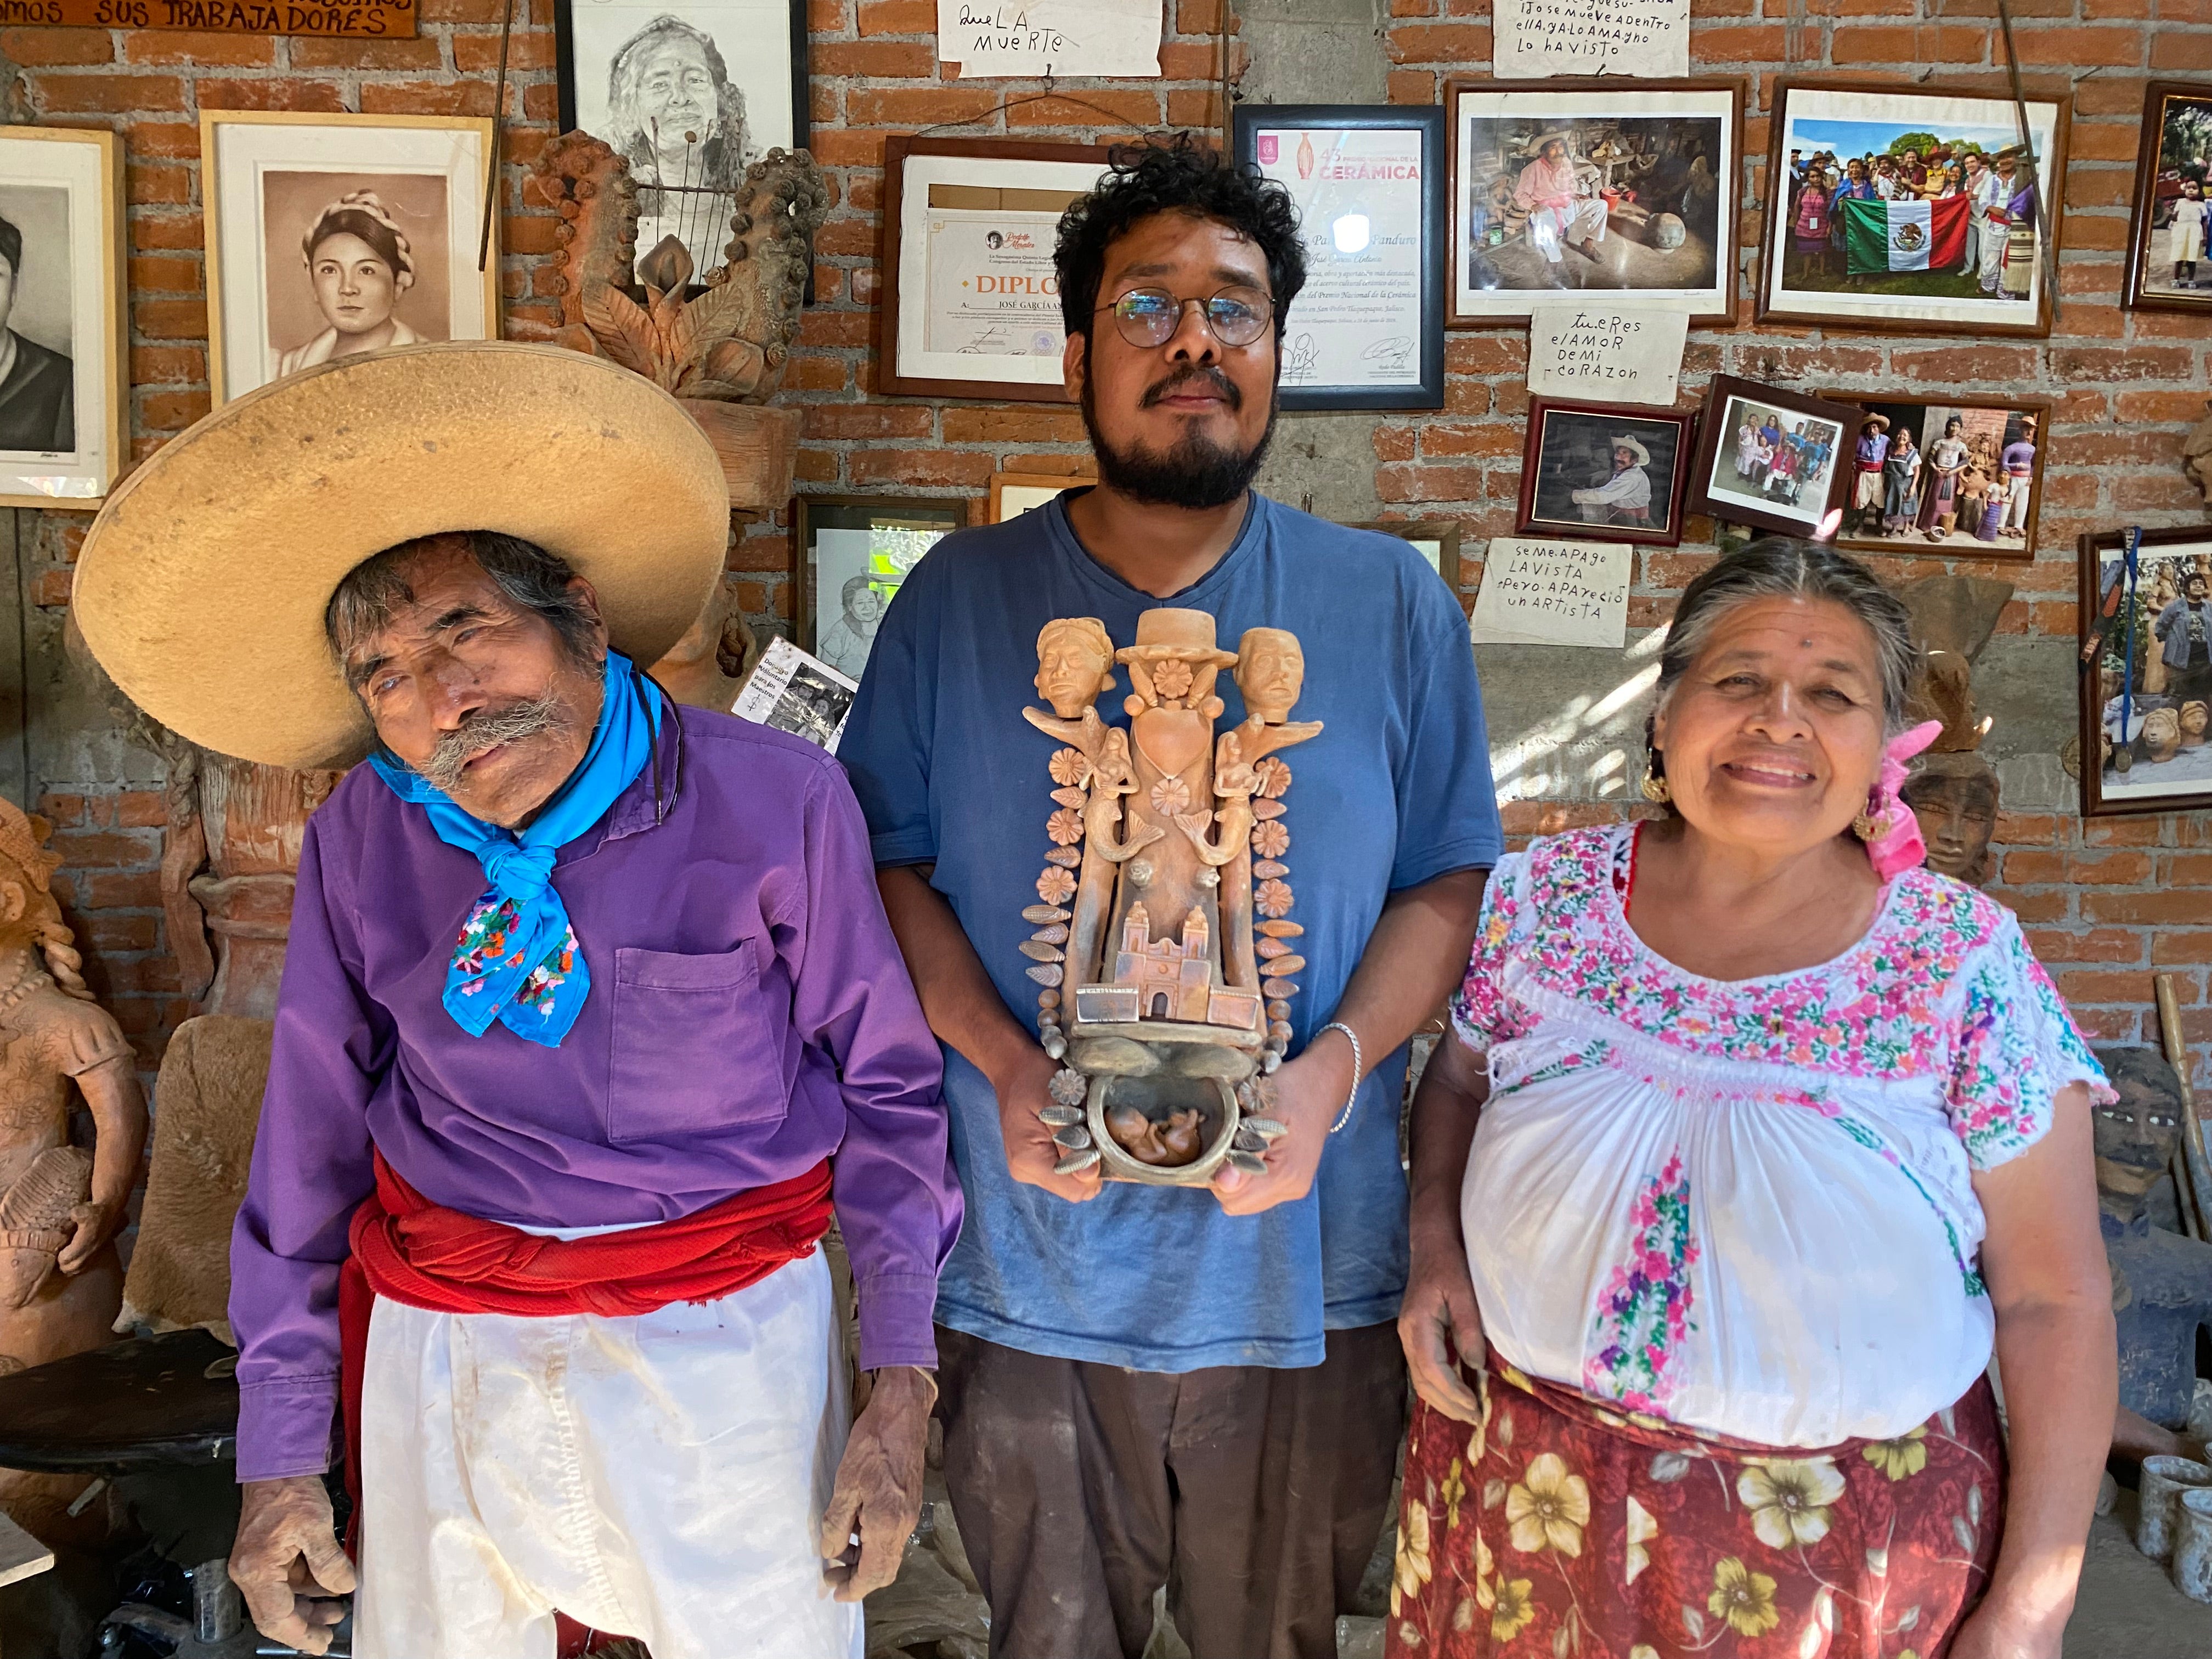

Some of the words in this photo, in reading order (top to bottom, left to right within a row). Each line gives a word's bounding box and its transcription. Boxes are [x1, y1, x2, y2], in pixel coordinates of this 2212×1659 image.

[0, 0, 63, 23] MOS
[94, 0, 149, 27] SUS
[162, 0, 386, 34] TRABAJADORES
[996, 6, 1028, 32] LA
[1321, 148, 1341, 162] 43
[1319, 163, 1420, 180] CERÁMICA
[1372, 233, 1417, 246] Panduro
[998, 300, 1017, 309] JOSÉ
[1509, 559, 1528, 573] LA
[750, 681, 776, 699] Maestros
